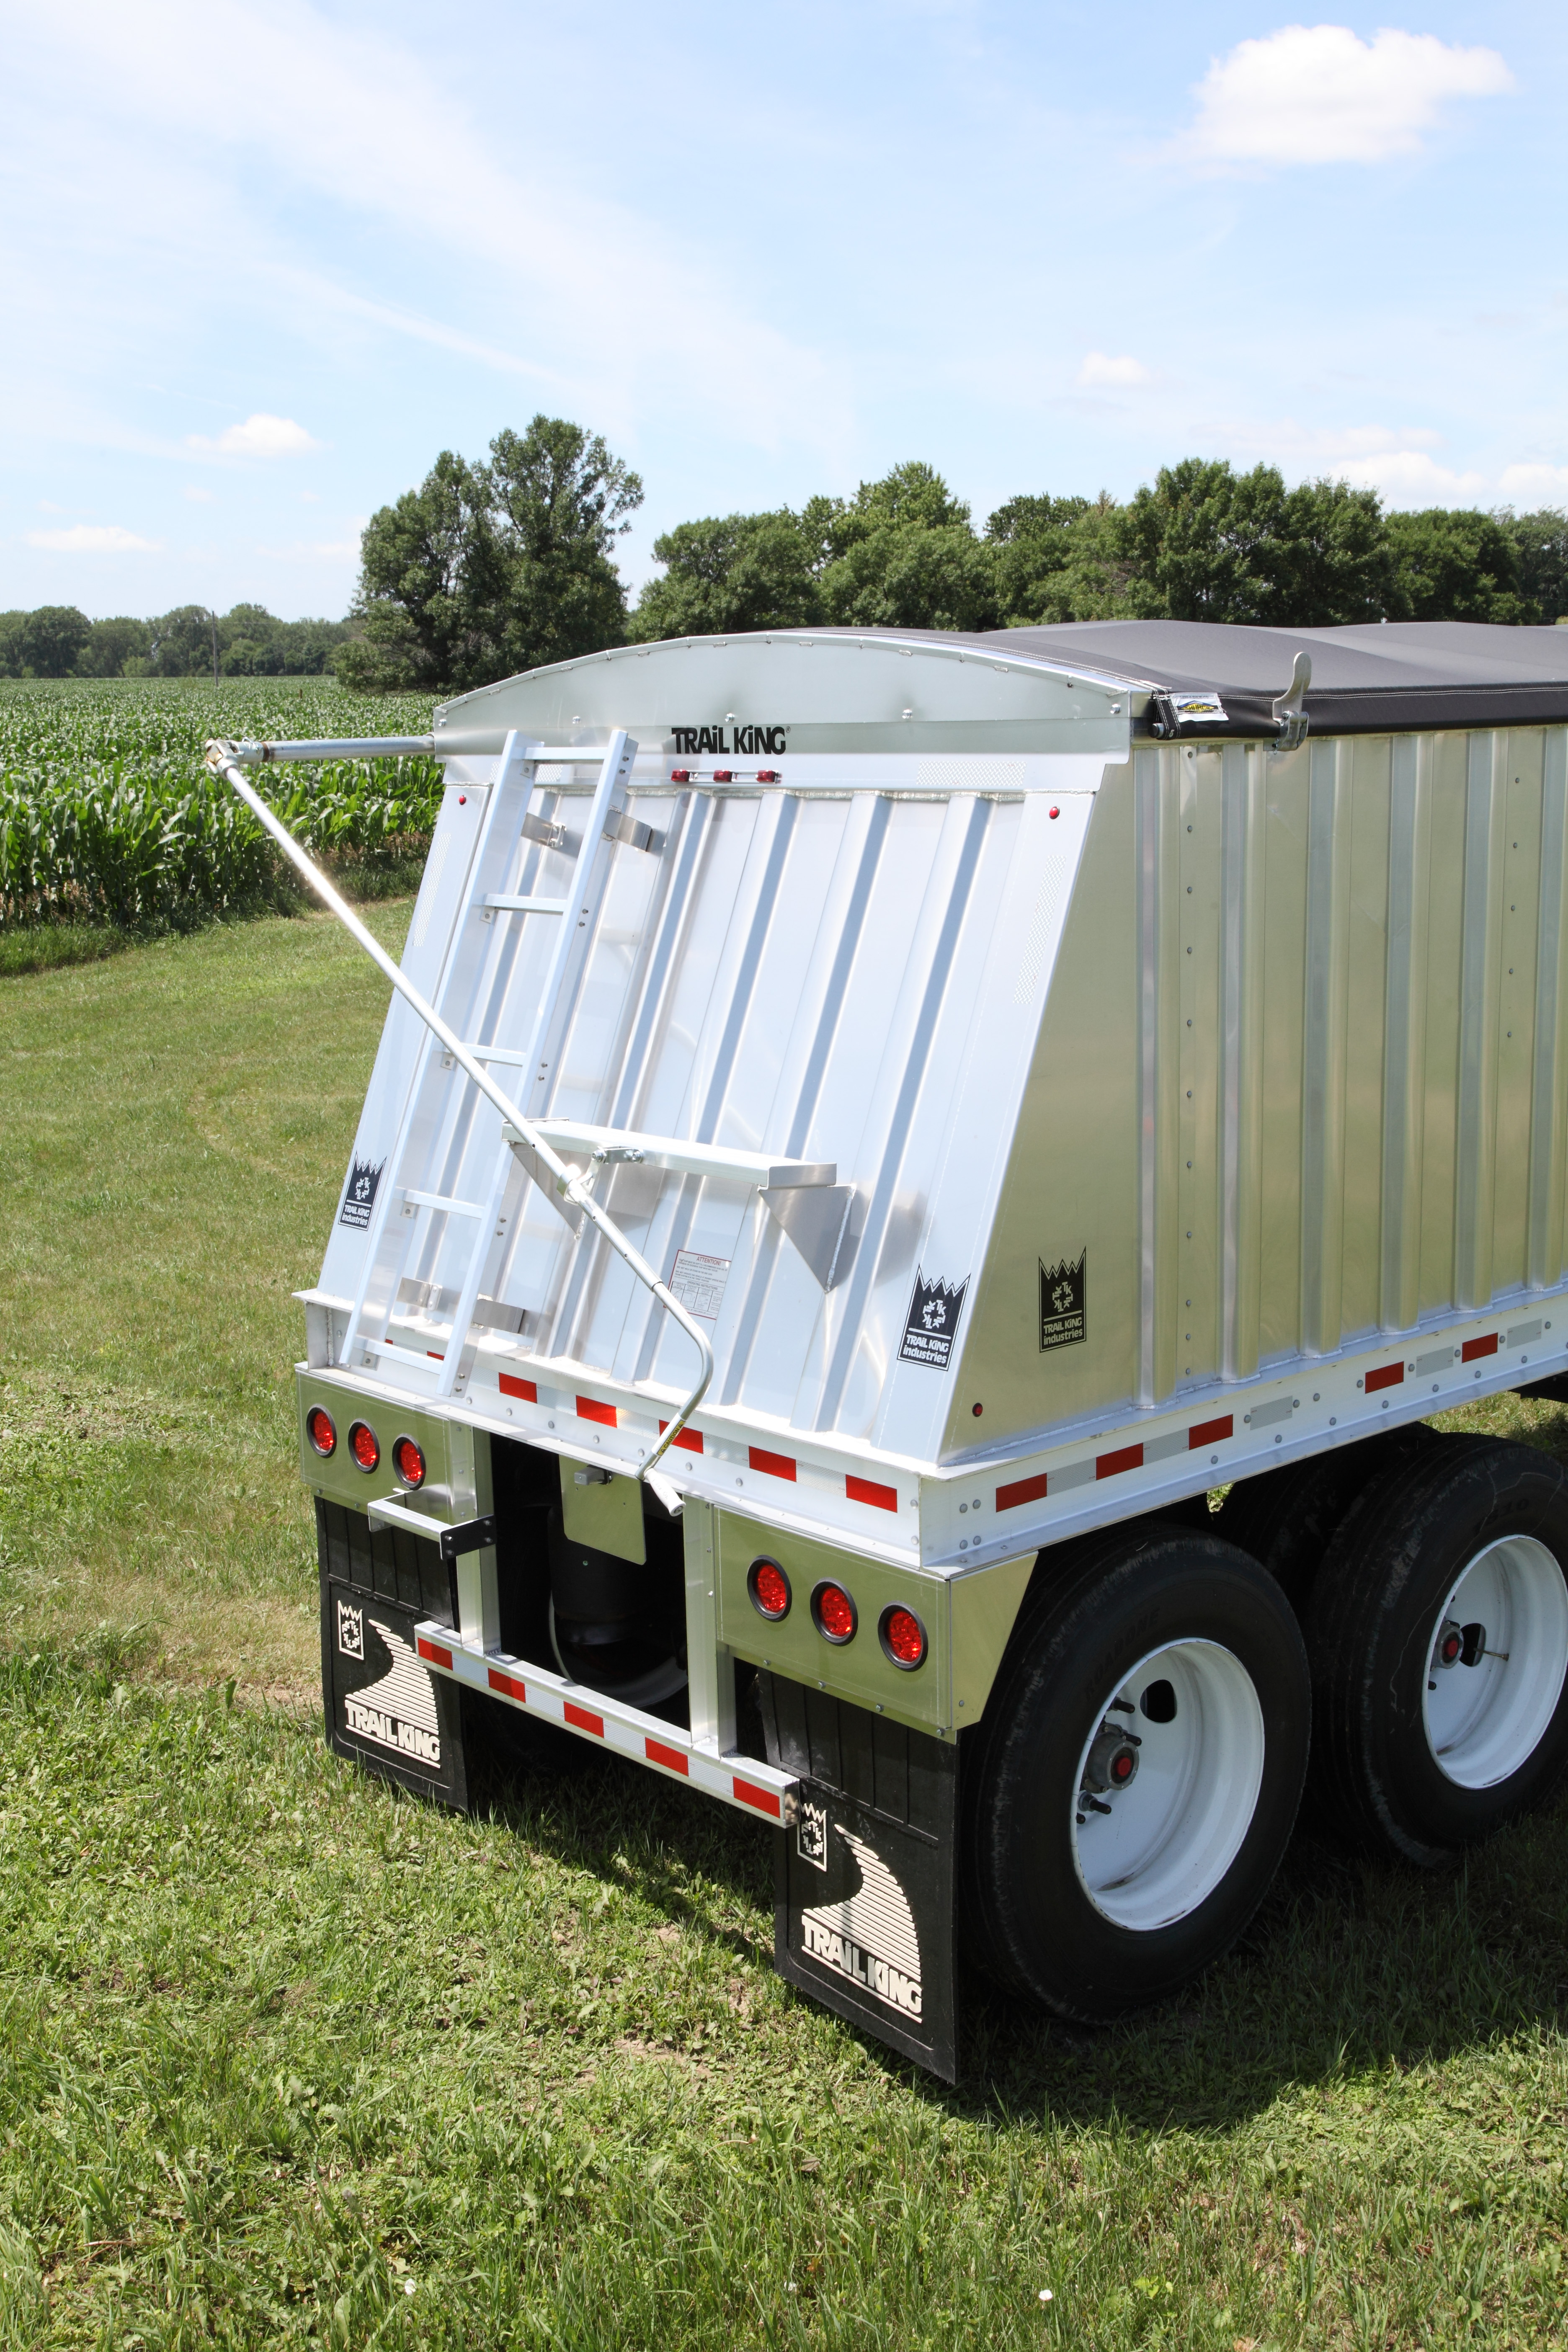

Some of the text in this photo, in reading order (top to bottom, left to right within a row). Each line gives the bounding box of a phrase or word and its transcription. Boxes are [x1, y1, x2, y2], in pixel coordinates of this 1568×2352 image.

[342, 1213, 368, 1226] industries
[696, 1256, 721, 1266] ATTENTION!
[1044, 1328, 1083, 1345] industries
[903, 1345, 947, 1364] industries
[663, 1428, 679, 1448] CAUTION
